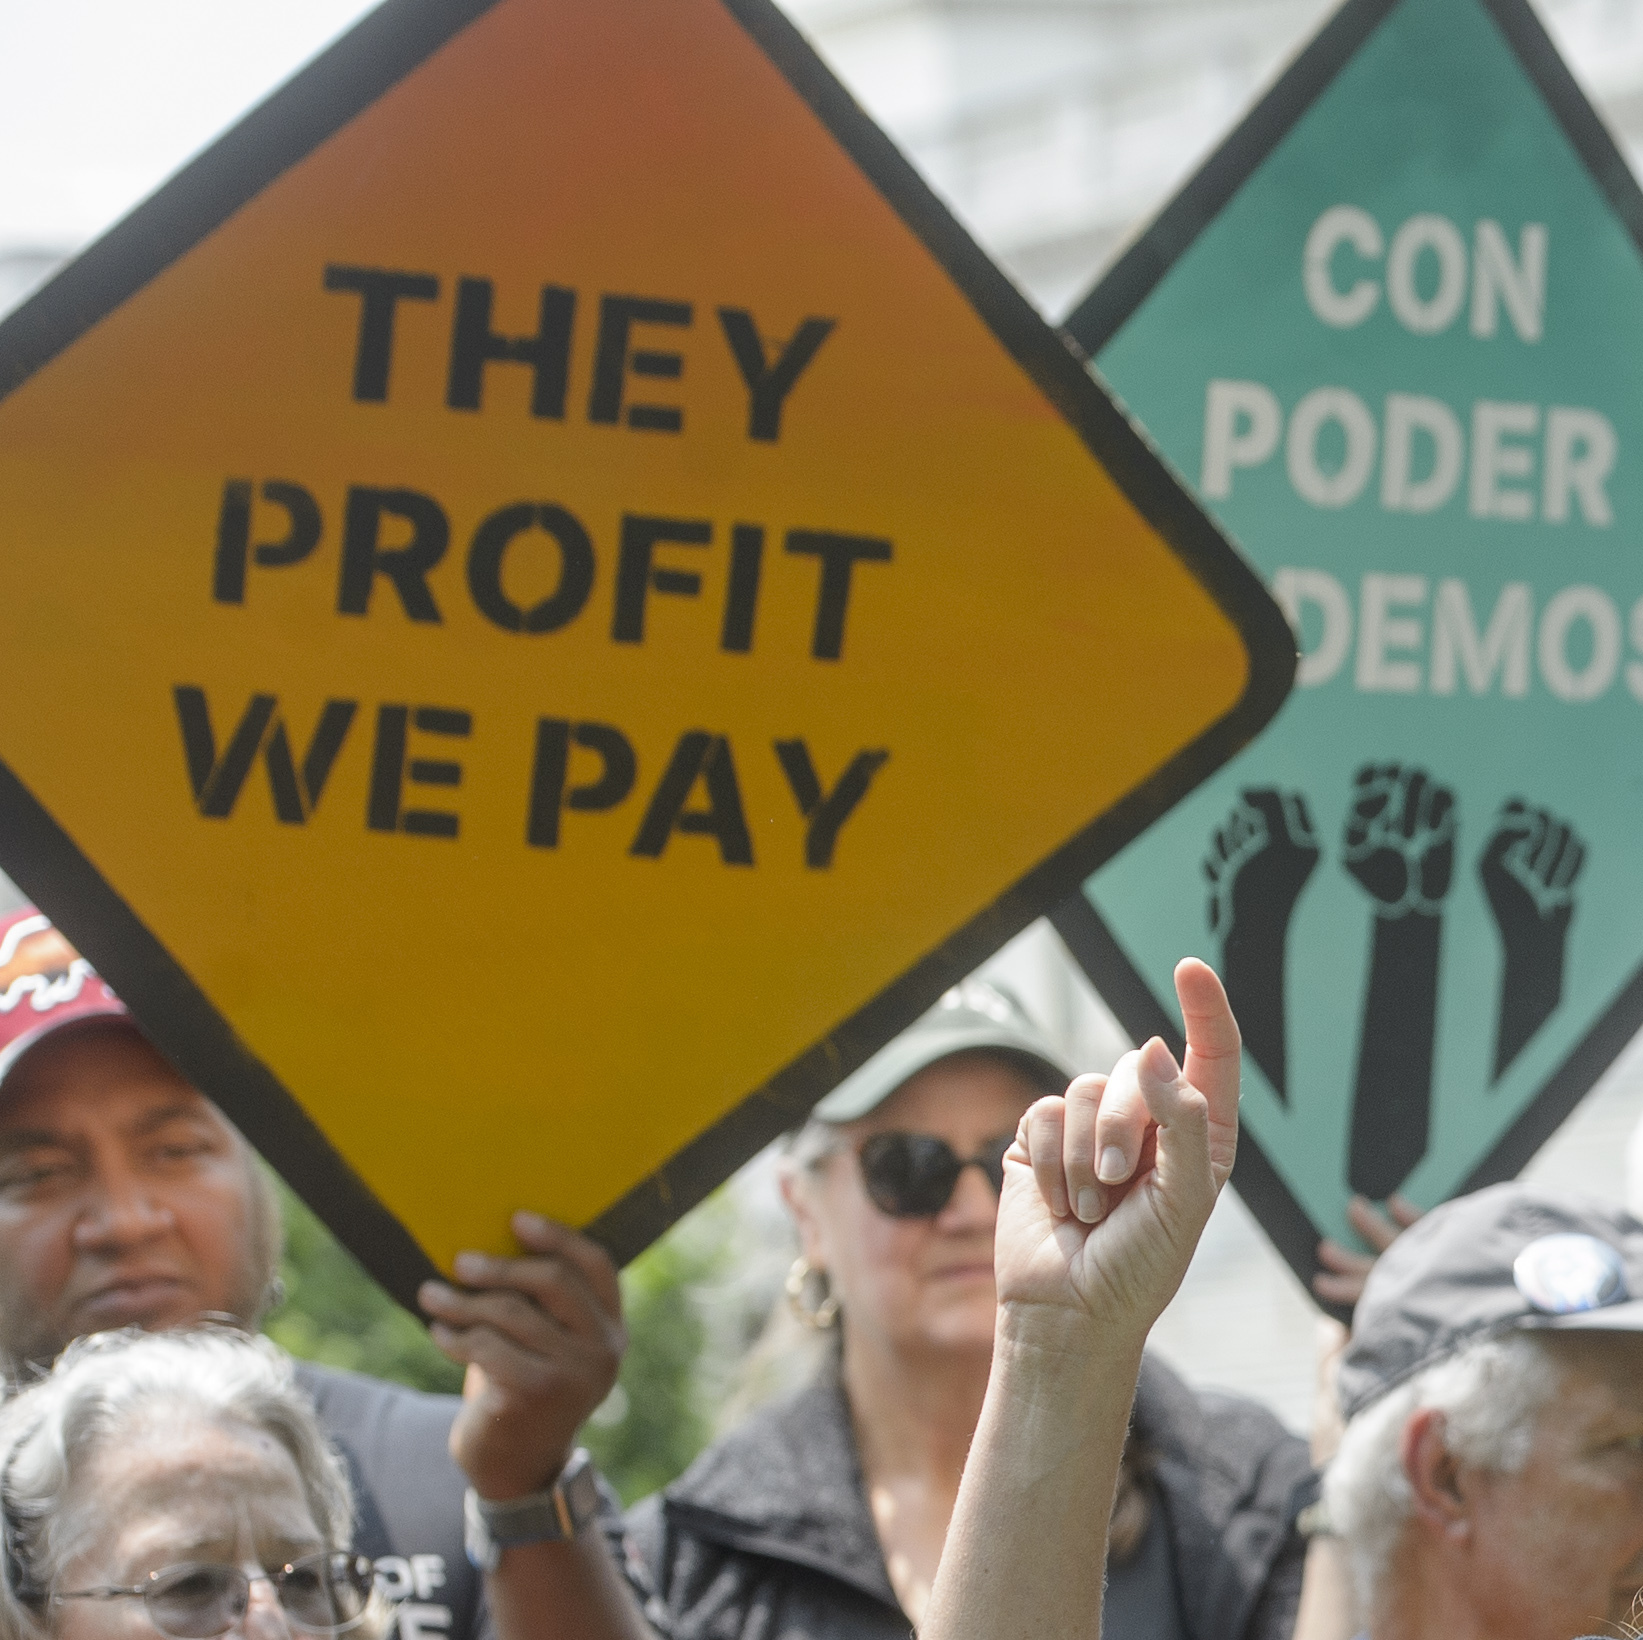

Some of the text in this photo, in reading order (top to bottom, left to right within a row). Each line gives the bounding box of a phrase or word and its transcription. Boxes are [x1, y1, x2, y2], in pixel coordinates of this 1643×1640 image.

[323, 262, 838, 444] THEY
[1303, 203, 1549, 343] CON
[1200, 378, 1620, 529] PODER
[212, 477, 894, 662] PROFIT
[172, 684, 891, 872] WE PAY
